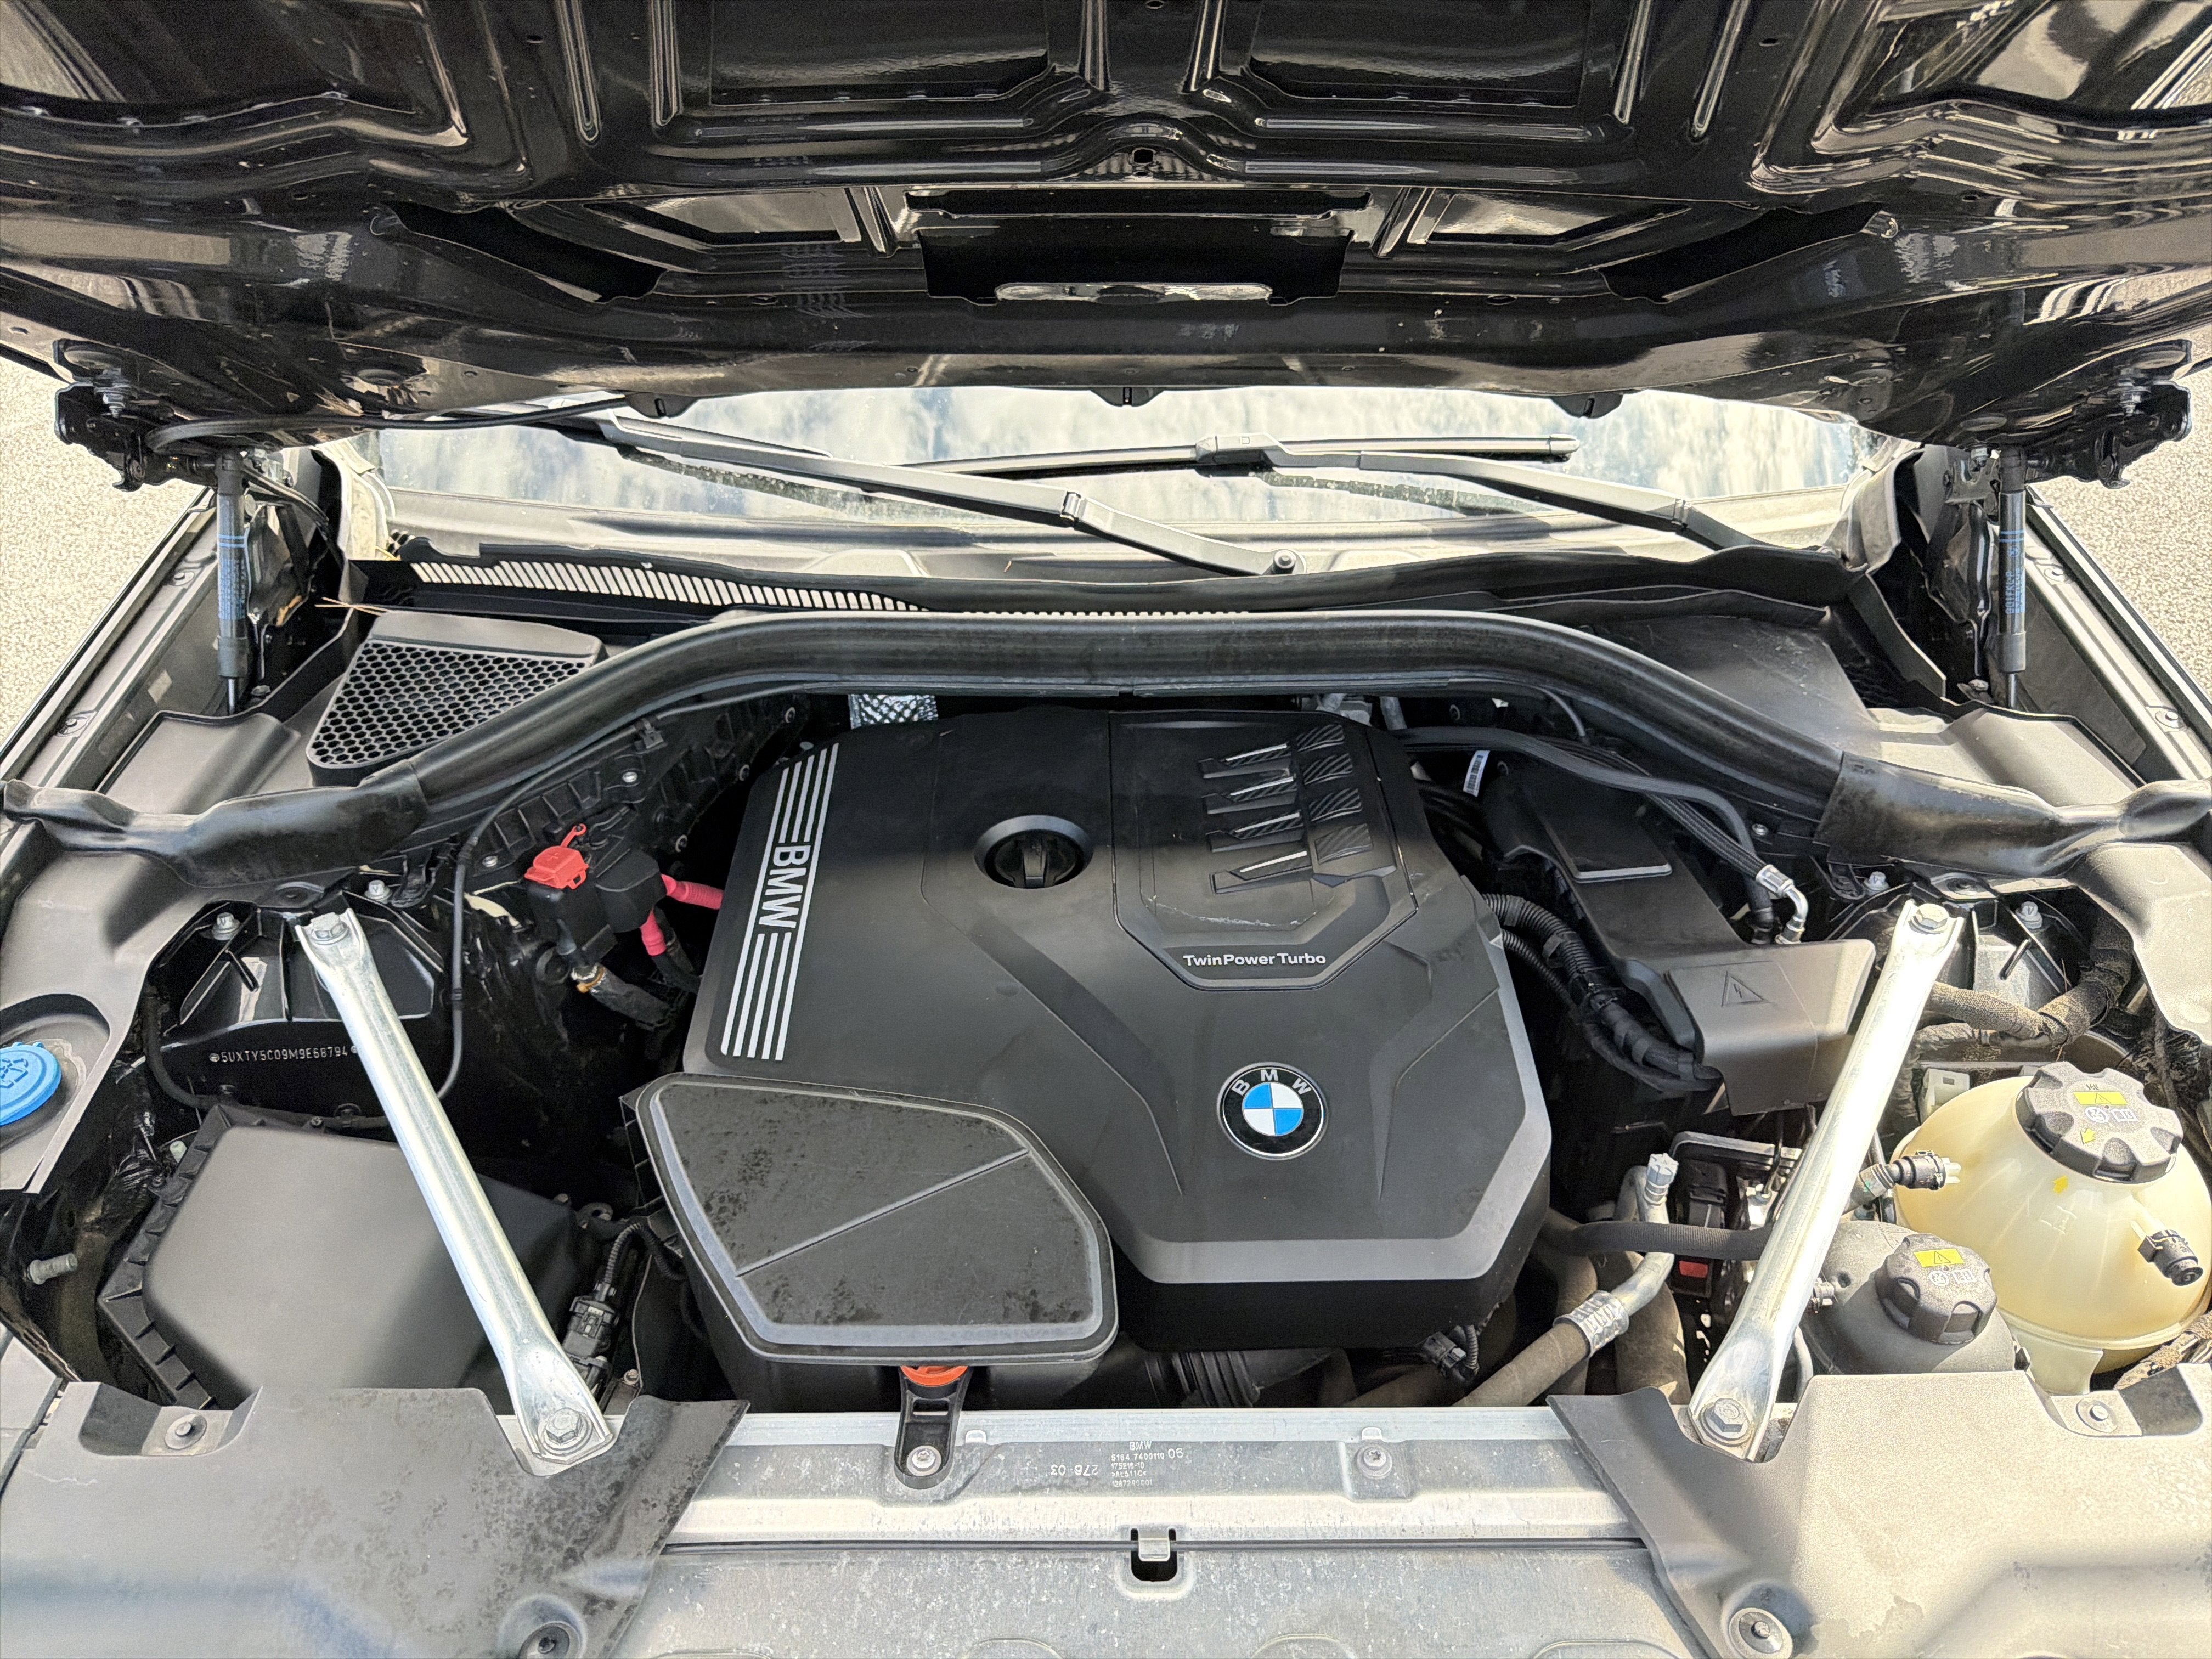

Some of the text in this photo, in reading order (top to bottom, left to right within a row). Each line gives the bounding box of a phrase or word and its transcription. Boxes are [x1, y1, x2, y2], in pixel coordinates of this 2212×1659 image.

[758, 844, 812, 929] BMW
[1183, 953, 1327, 966] TwinPower Turbo
[1231, 1069, 1312, 1096] BMW
[1129, 1441, 1152, 1451] BMW
[1133, 1452, 1165, 1461] 7400110
[1167, 1447, 1183, 1459] 06
[1050, 1464, 1066, 1476] 03
